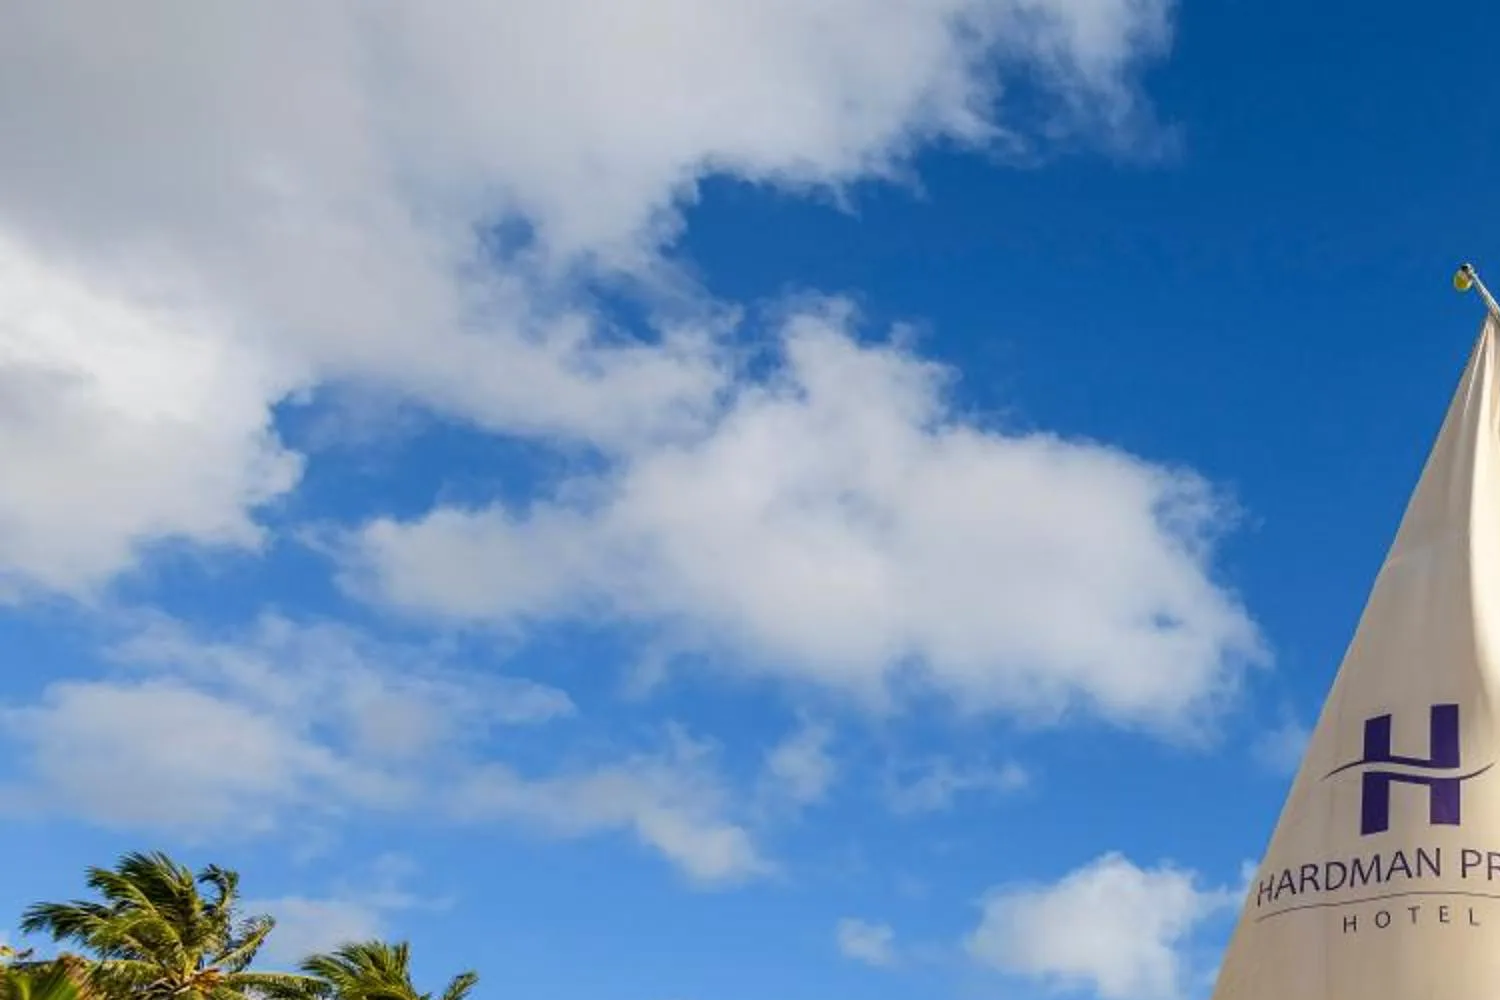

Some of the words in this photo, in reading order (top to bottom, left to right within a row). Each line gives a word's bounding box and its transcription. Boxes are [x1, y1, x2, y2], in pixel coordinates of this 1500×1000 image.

[1359, 703, 1463, 836] H
[1256, 848, 1442, 907] HARDMAN
[1343, 906, 1481, 934] HOTEL
